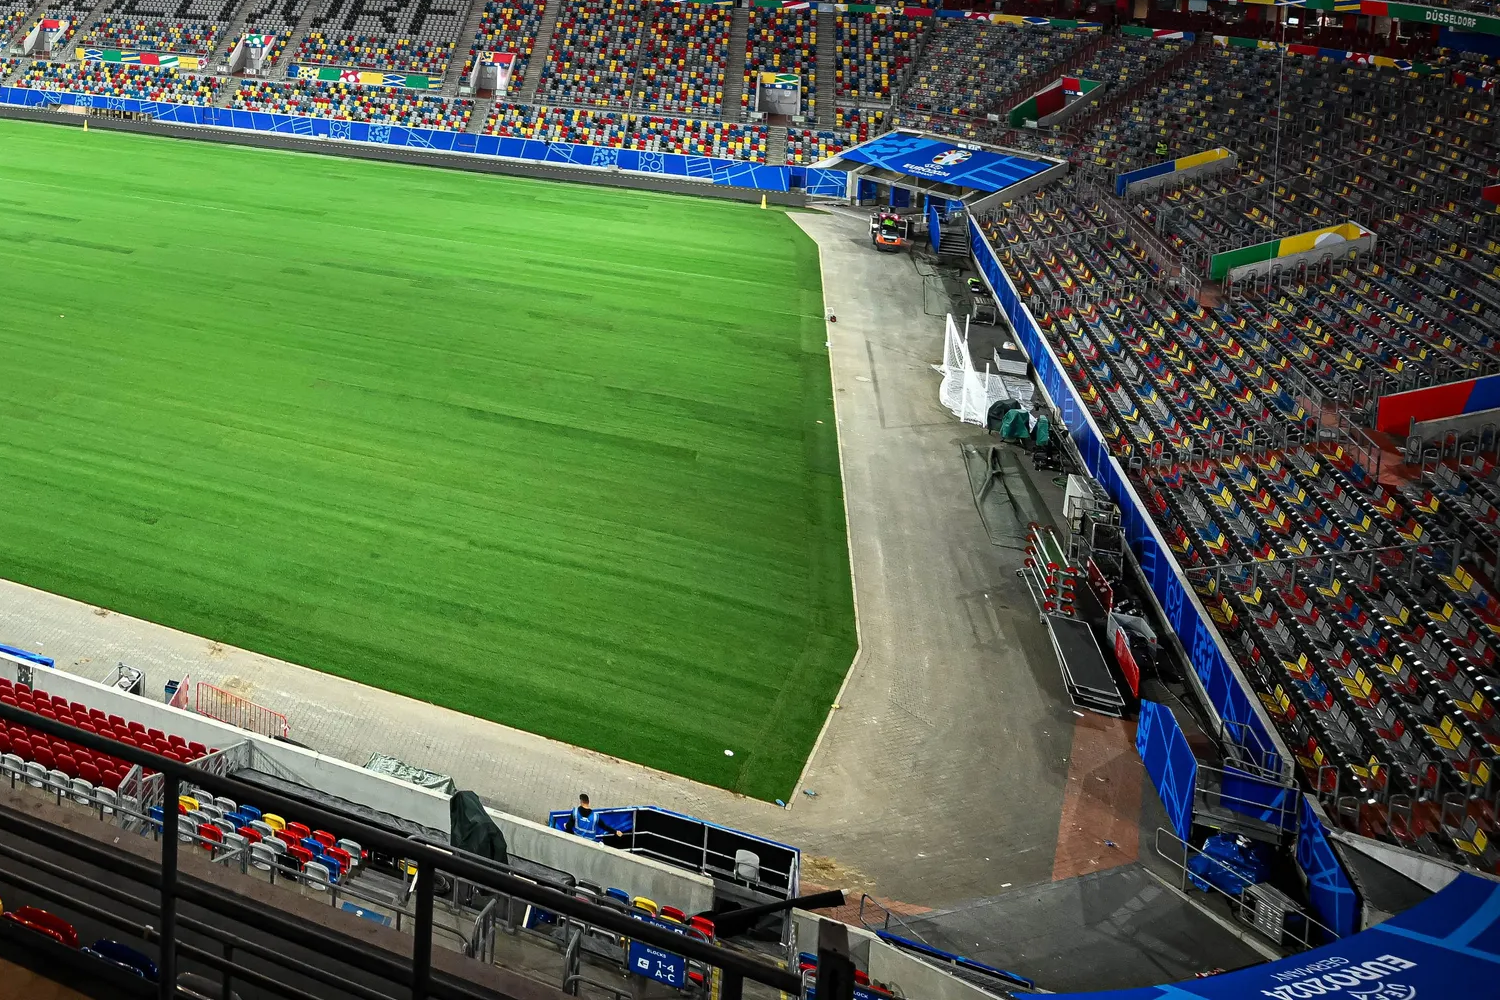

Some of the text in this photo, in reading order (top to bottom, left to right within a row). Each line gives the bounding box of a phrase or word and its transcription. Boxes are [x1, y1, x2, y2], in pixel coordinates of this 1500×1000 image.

[1425, 10, 1477, 28] DÜSSELDORF
[646, 948, 667, 959] BLOCKS
[656, 960, 675, 973] 1-4
[1270, 956, 1350, 982] GERMANY
[654, 969, 676, 983] A-C
[1260, 954, 1418, 1000] EURO2024
[853, 990, 869, 999] LOCK
